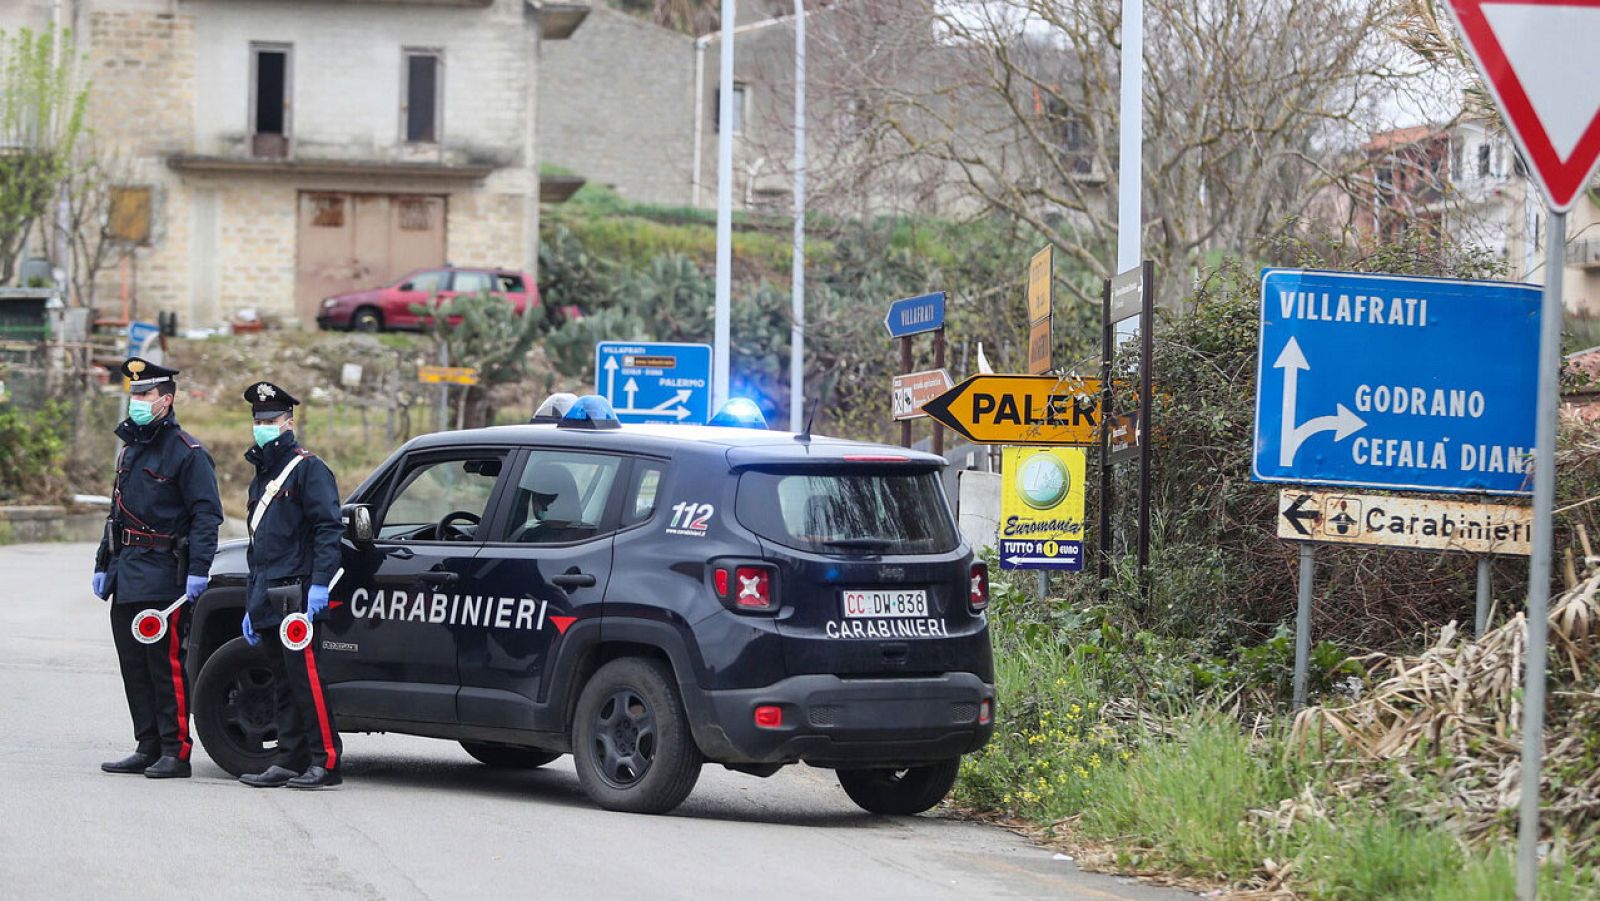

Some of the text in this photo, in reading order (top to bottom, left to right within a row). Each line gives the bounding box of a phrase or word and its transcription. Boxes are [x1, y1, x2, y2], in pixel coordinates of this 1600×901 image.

[901, 304, 934, 327] VILLAFRATI
[1280, 291, 1427, 327] VILLAFRATI
[659, 378, 705, 388] PALERMO
[973, 393, 1098, 427] PALER
[1355, 384, 1485, 418] GODRANO
[670, 501, 714, 530] 112
[1004, 516, 1081, 536] Euromania
[1366, 507, 1530, 542] Carabinieri
[1004, 542, 1034, 553] TUTTO
[1036, 543, 1043, 553] A
[1059, 545, 1079, 554] EURO
[351, 587, 548, 631] CARABINIERI
[847, 593, 925, 614] CC DW 838
[826, 618, 949, 639] CARABINIERI
